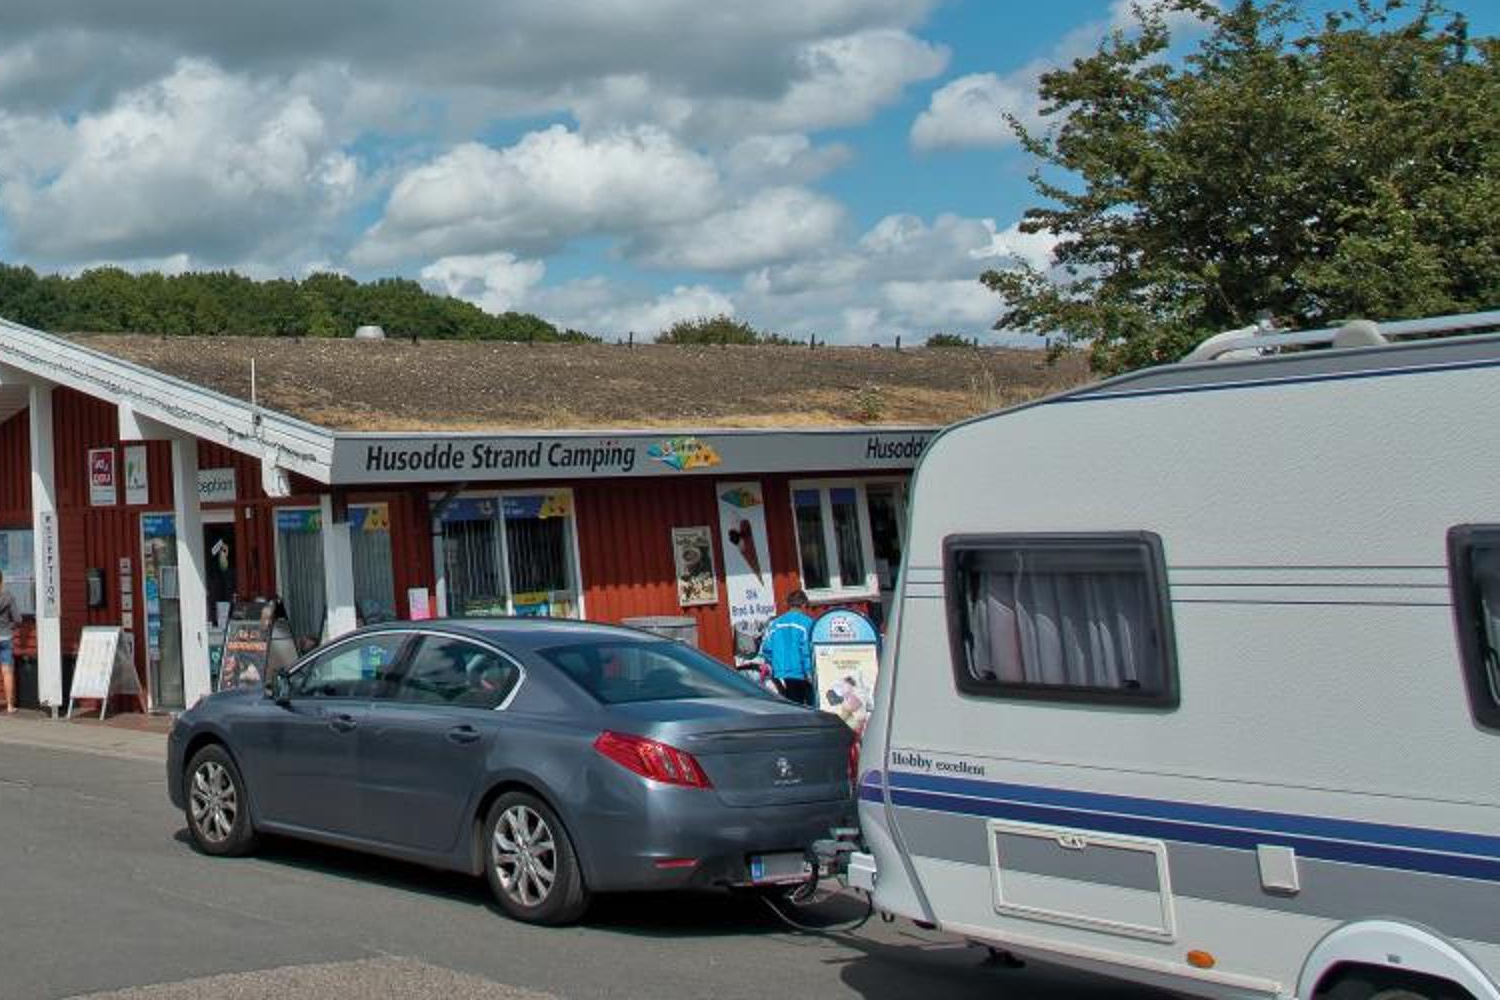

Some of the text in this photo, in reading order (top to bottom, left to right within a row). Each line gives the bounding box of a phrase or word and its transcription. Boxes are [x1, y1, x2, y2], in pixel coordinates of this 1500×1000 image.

[366, 440, 636, 473] Husodde Strand Camping
[866, 435, 929, 459] Husodd
[892, 751, 985, 776] Hobby excellent
